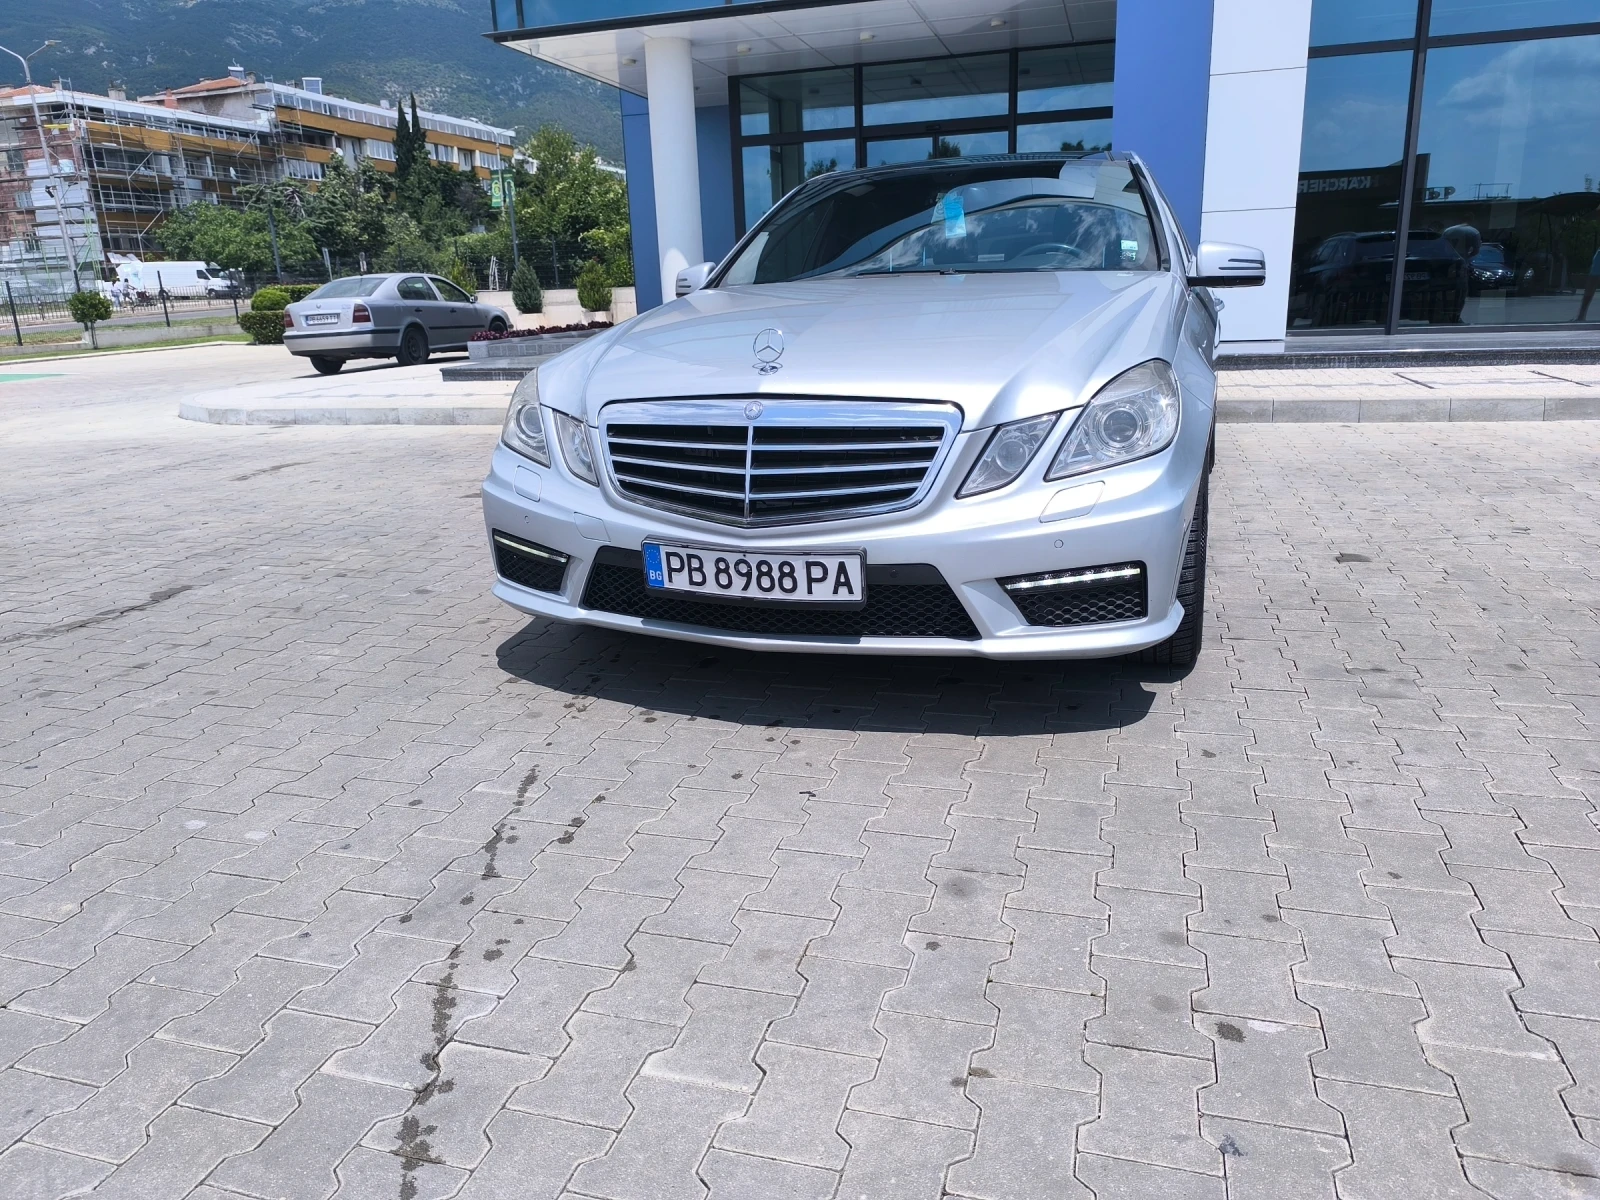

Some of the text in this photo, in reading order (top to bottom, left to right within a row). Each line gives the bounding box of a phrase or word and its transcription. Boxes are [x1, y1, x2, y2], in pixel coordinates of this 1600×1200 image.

[649, 570, 663, 581] BG
[664, 551, 855, 595] PB 8988 PA
